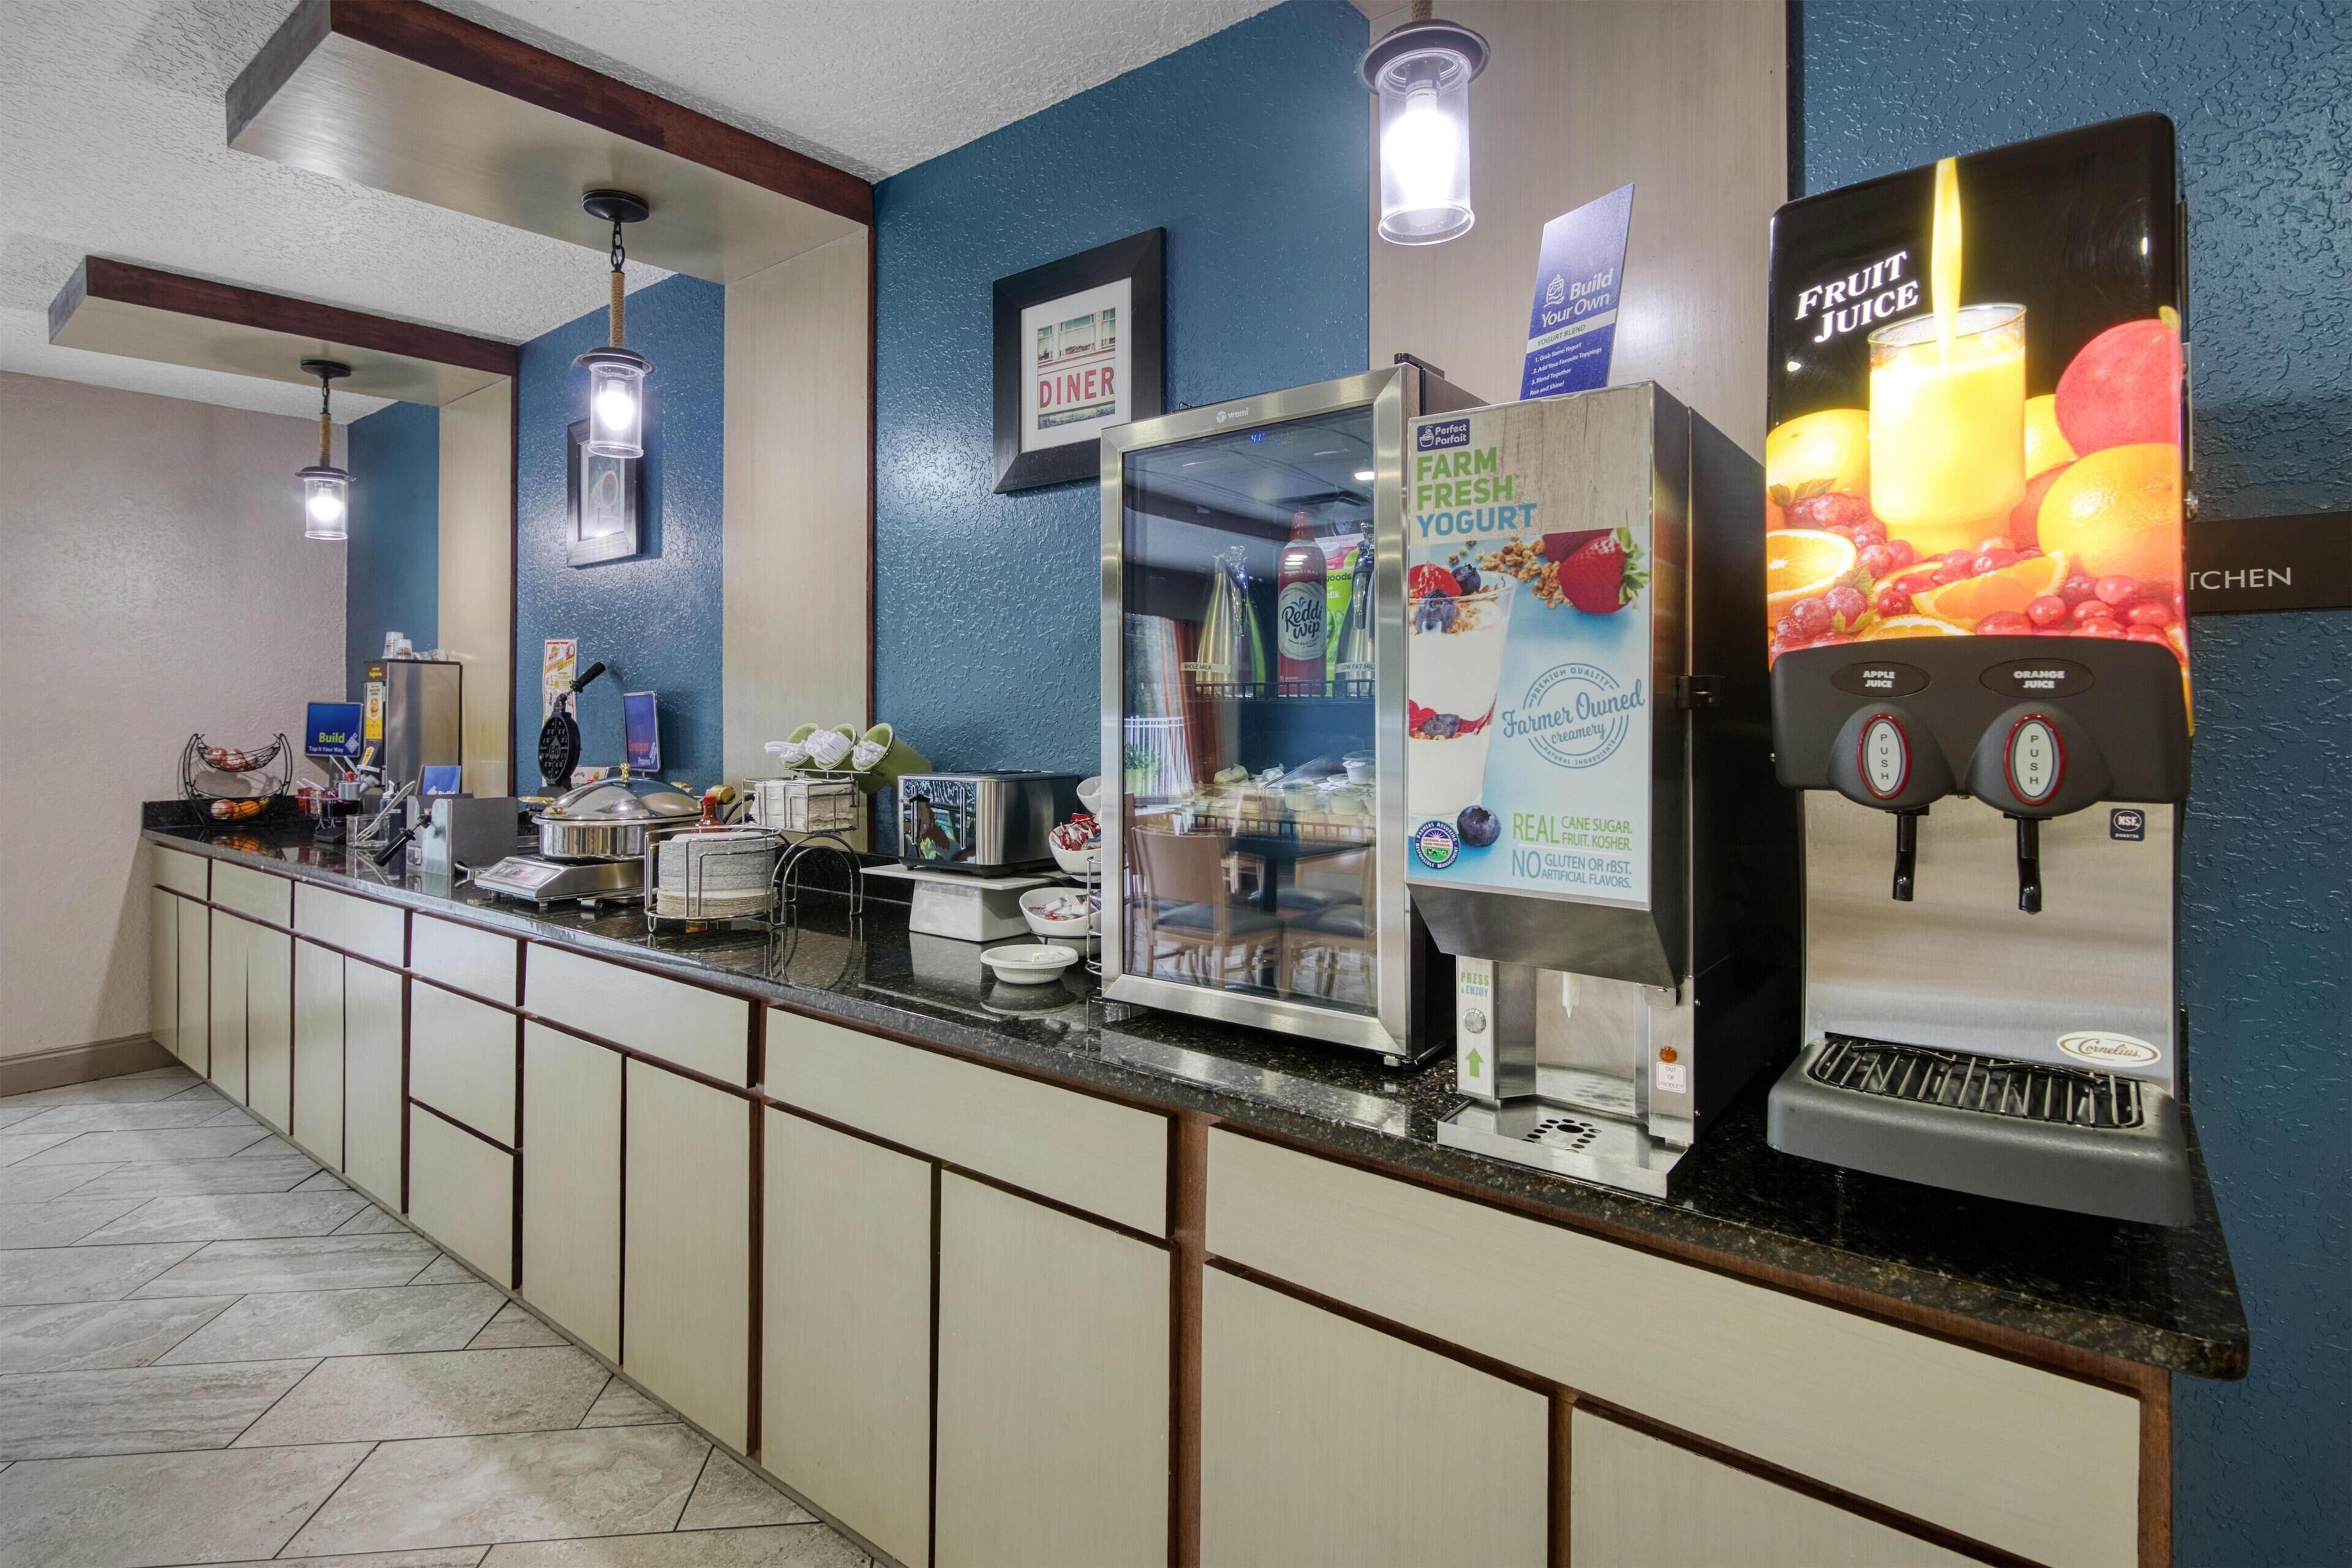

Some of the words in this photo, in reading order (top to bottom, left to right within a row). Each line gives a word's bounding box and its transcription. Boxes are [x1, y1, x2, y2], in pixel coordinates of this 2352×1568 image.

[1570, 268, 1613, 301] Build
[1795, 251, 1907, 321] FRUIT
[1541, 304, 1574, 328] Your
[1575, 293, 1610, 317] Own
[1814, 281, 1918, 343] JUICE
[1537, 332, 1563, 347] YOGURT
[1564, 324, 1586, 338] BLEND
[1551, 349, 1565, 357] Some
[1565, 342, 1582, 353] Yogurt
[1559, 355, 1579, 365] Favorite
[1579, 347, 1602, 359] Toppings
[1550, 368, 1572, 379] Together
[1039, 366, 1115, 409] DINER
[1227, 407, 1249, 419] vremi
[1435, 424, 1466, 435] Perfect
[1435, 434, 1466, 445] Parfait
[1417, 447, 1497, 481] FARM
[1417, 475, 1512, 510] FRESH
[1416, 503, 1537, 538] YOGURT
[2190, 567, 2291, 590] TCHEN
[1282, 599, 1322, 632] Reddi
[1293, 620, 1320, 639] wip
[1532, 668, 1567, 699] PREMIUM
[1570, 666, 1610, 687] QUALITY
[2013, 670, 2065, 679] ORANGE
[2022, 680, 2055, 688] JUICE
[1502, 706, 1574, 738] Farmer
[1576, 679, 1645, 720] Owned
[319, 733, 345, 744] Build
[1551, 723, 1607, 744] creamery
[1543, 746, 1571, 765] NATURAL
[1575, 739, 1616, 765] INGREDIENTS
[1880, 734, 1889, 781] PUSH
[2030, 735, 2039, 785] PUSH
[1513, 812, 1560, 844] REAL
[1562, 816, 1591, 831] CANE
[1593, 818, 1632, 834] SUGAR.
[2118, 815, 2138, 826] NSF
[1416, 822, 1434, 839] FARMERS
[1436, 822, 1458, 842] ASSURING
[1562, 832, 1590, 847] FRUIT.
[1592, 835, 1632, 851] KOSHER.
[1415, 842, 1434, 867] RESPONSIBLE
[1512, 848, 1541, 879] NO
[1545, 853, 1586, 870] GLUTEN
[1588, 858, 1604, 872] OR
[1606, 860, 1632, 875] rBST.
[1541, 869, 1587, 883] ARTIFICIAL
[1589, 873, 1632, 888] FLAVORS.
[1461, 971, 1489, 986] PRESS
[1466, 985, 1489, 997] ENJOY
[2078, 1038, 2138, 1057] Cornelius
